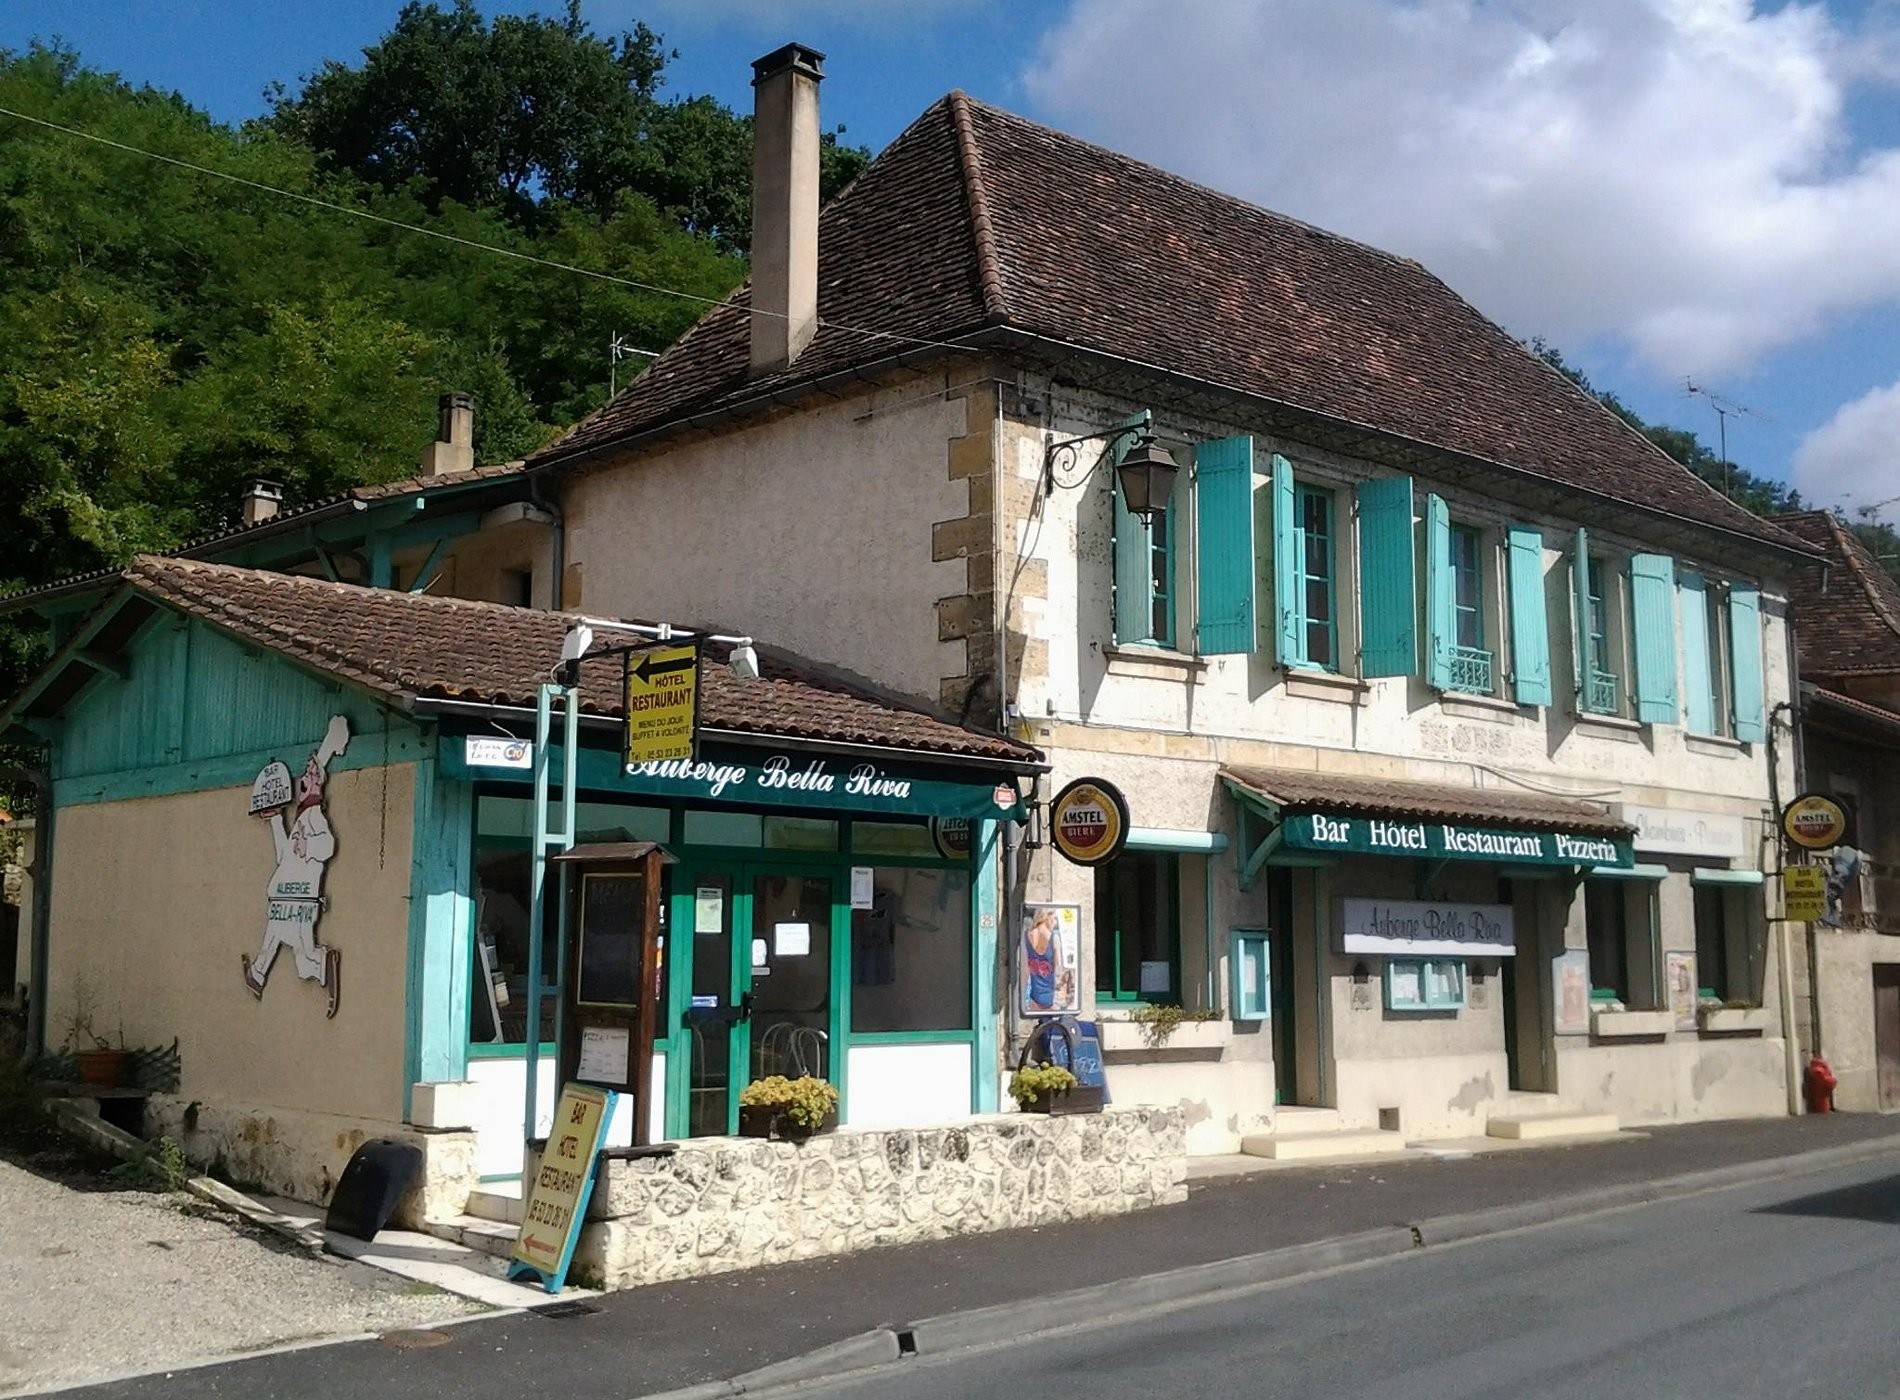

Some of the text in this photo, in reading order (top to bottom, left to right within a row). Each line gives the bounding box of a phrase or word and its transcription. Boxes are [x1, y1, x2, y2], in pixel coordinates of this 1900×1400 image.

[655, 674, 685, 688] HÔTEL
[632, 688, 692, 712] RESTAURANT
[264, 764, 279, 778] BAR
[758, 755, 833, 792] Bella
[845, 763, 910, 798] Riva
[252, 785, 290, 809] RESTAURANT
[1062, 811, 1103, 824] AMSTEL
[1795, 814, 1832, 823] AMSTEL
[1311, 814, 1618, 862] Bar Hôtel Restaurant Pizzeria
[277, 882, 311, 894] AUBERGE
[1361, 907, 1502, 944] Auberge Bella Riva
